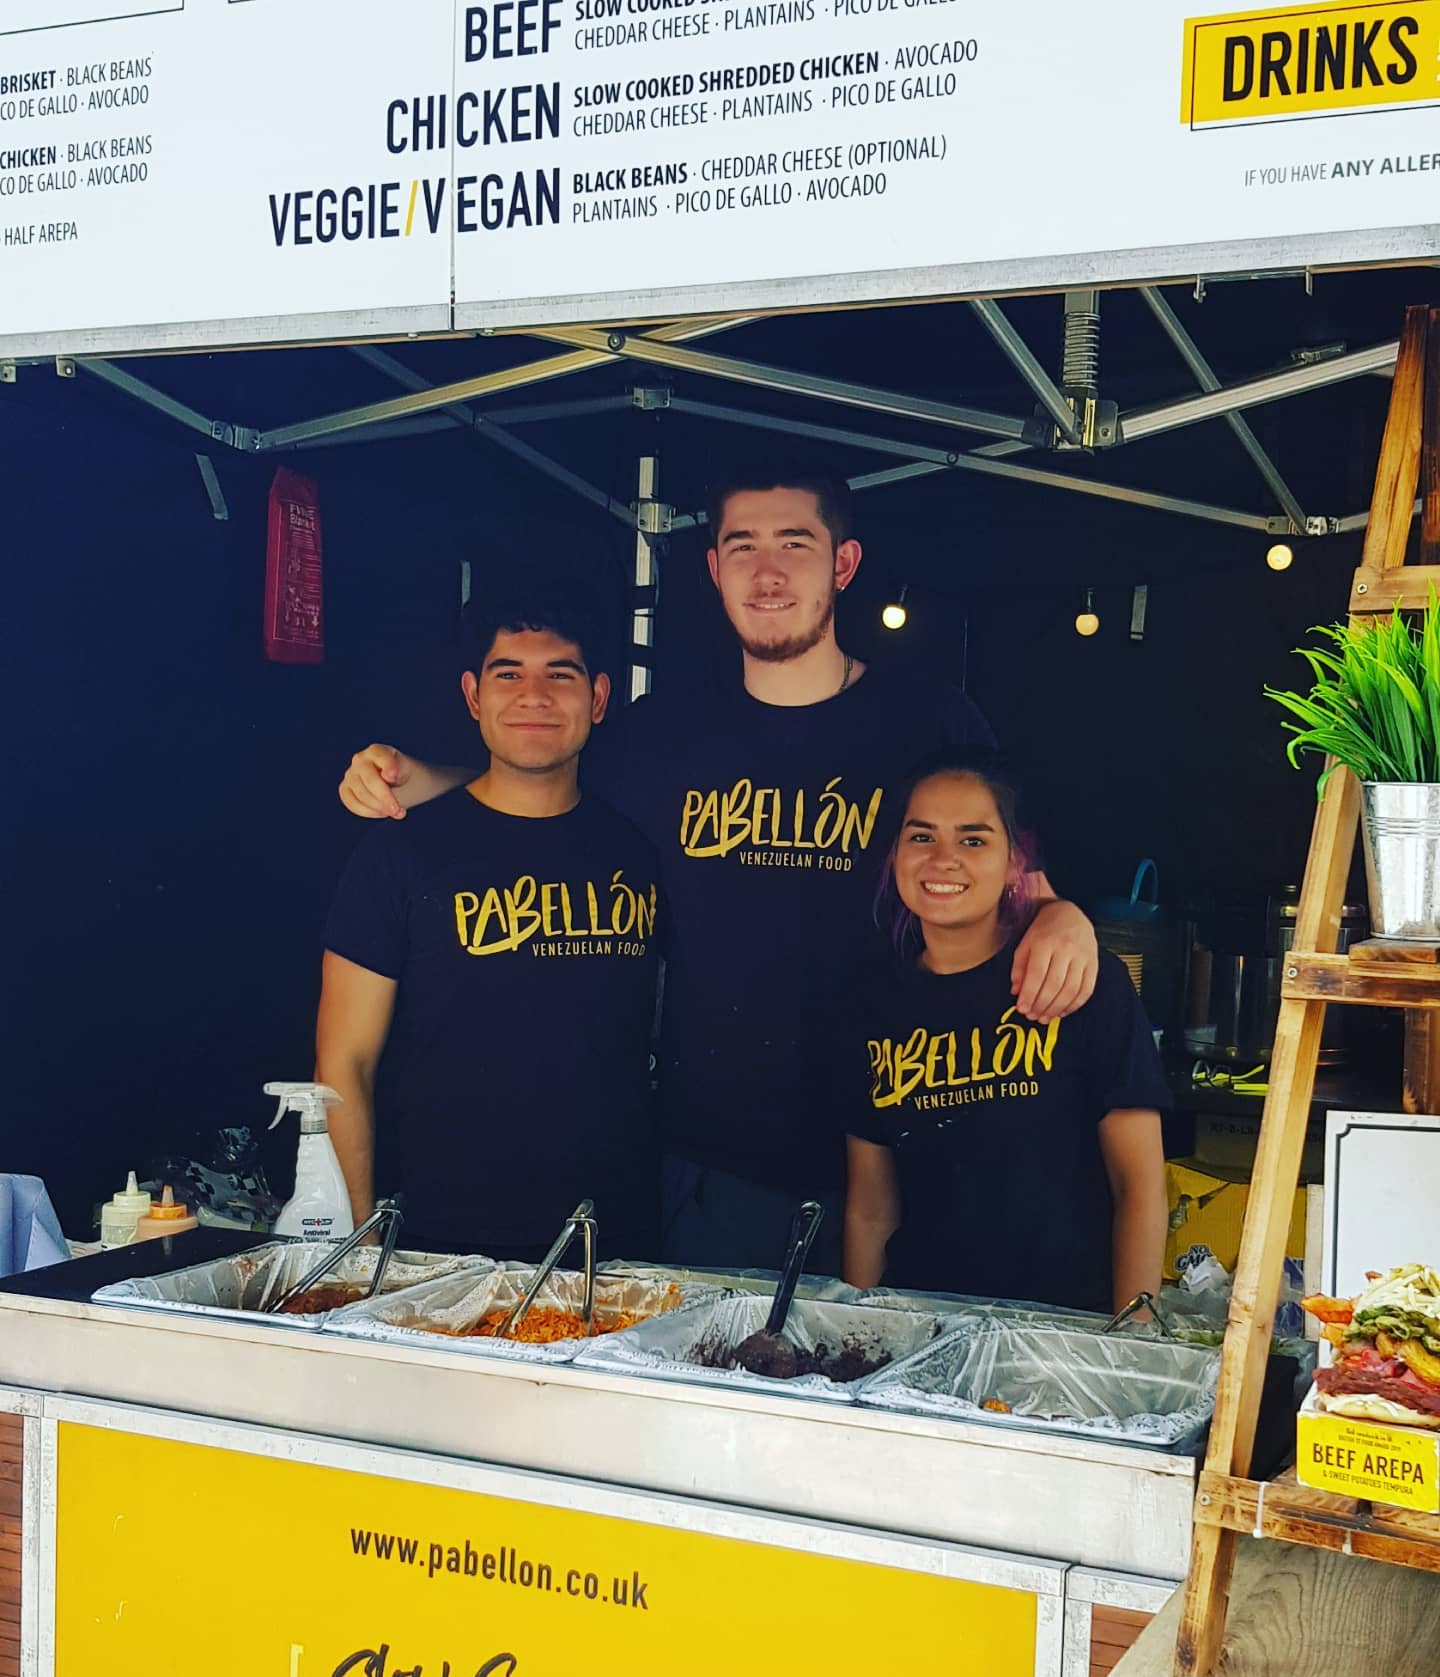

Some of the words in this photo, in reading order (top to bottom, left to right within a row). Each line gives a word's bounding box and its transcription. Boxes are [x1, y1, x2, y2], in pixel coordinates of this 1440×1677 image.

[465, 0, 563, 62] BEEF
[575, 21, 647, 50] CHEDDAR
[653, 13, 710, 40] CHEESE
[724, 0, 815, 32] PLANTAINS
[834, 0, 871, 17] PICO
[576, 0, 622, 20] SLOW
[627, 0, 695, 13] COO
[0, 70, 56, 94] BRISKET
[67, 63, 106, 86] BLACK
[110, 57, 152, 81] BEANS
[574, 82, 621, 107] SLOW
[625, 75, 693, 102] COOKED
[699, 61, 795, 94] SHREDDED
[800, 51, 879, 81] CHICKEN
[894, 39, 978, 70] AVOCADO
[1223, 16, 1419, 102] DRINKS
[19, 98, 35, 118] DE
[38, 94, 77, 116] GALLO
[88, 85, 149, 110] AVOCADO
[386, 82, 560, 154] CHICKEN
[573, 109, 645, 137] CHEDDAR
[650, 101, 708, 128] CHEESE
[722, 89, 813, 120] PLANTAINS
[831, 83, 869, 108] PICO
[875, 80, 896, 103] DE
[901, 73, 956, 100] GALLO
[0, 146, 56, 169] CHICKEN
[67, 140, 107, 162] BLACK
[111, 135, 152, 158] BEANS
[572, 168, 626, 194] BLACK
[631, 162, 688, 188] BEANS
[701, 154, 777, 181] CHEDDAR
[782, 145, 843, 173] CHEESE
[848, 134, 947, 170] (OPTIONAL)
[1244, 170, 1257, 187] IF
[1260, 167, 1287, 185] YOU
[1291, 163, 1327, 183] HAVE
[1331, 159, 1375, 179] ANY
[19, 175, 34, 193] DE
[37, 170, 76, 191] GALLO
[87, 162, 148, 187] AVOCADO
[573, 195, 658, 223] PLANTAINS
[675, 190, 711, 214] PICO
[716, 188, 735, 209] DE
[740, 182, 791, 207] GALLO
[806, 173, 886, 201] AVOCADO
[269, 167, 560, 246] VEGGIE/VEGAN
[4, 225, 35, 246] HALF
[39, 221, 78, 243] AREPA
[680, 776, 883, 858] PABELLÓN
[740, 851, 812, 868] VENEZUELAN
[818, 855, 852, 872] FOOD
[455, 870, 657, 956] PABELLÓN
[532, 941, 612, 957] VENEZUELAN
[617, 943, 646, 957] FOOD
[867, 1006, 1061, 1108] PABELLÓN
[914, 1085, 994, 1110] VENEZUELAN
[1001, 1081, 1039, 1097] FOOD
[1313, 1443, 1356, 1470] BEEF
[1363, 1454, 1424, 1484] AREPA
[350, 1528, 648, 1609] www.pabellon.co.uk
